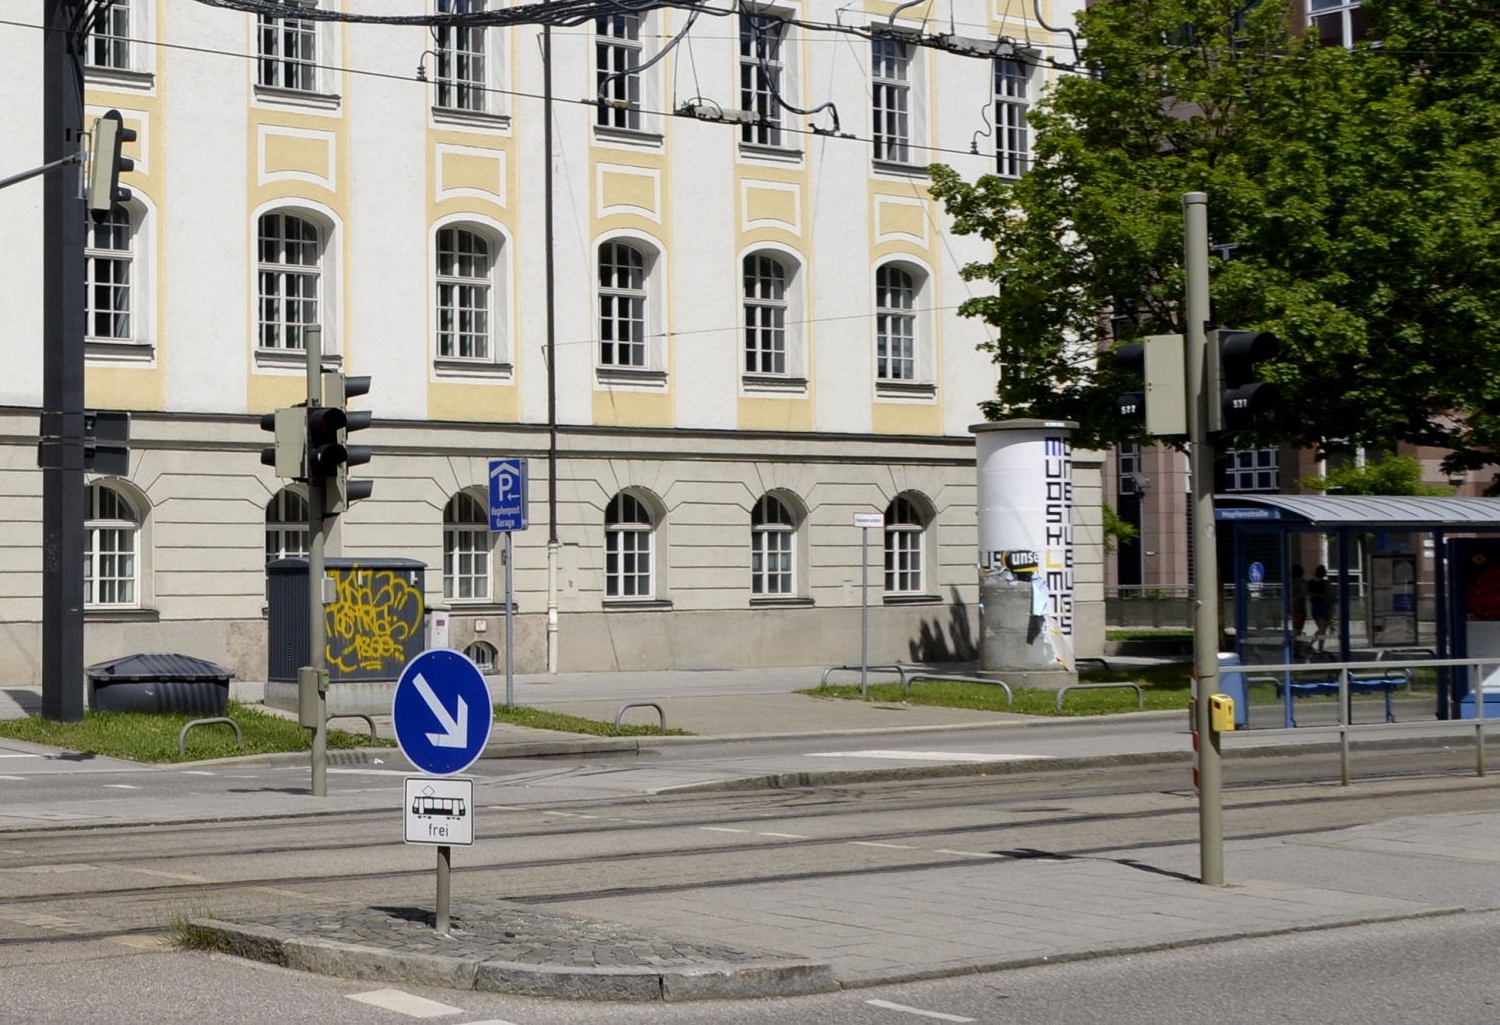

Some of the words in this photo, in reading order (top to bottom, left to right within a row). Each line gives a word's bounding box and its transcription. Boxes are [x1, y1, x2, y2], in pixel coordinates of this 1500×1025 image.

[1221, 509, 1269, 519] Hopfenstraße
[496, 518, 516, 529] Garage
[428, 823, 449, 837] frei
